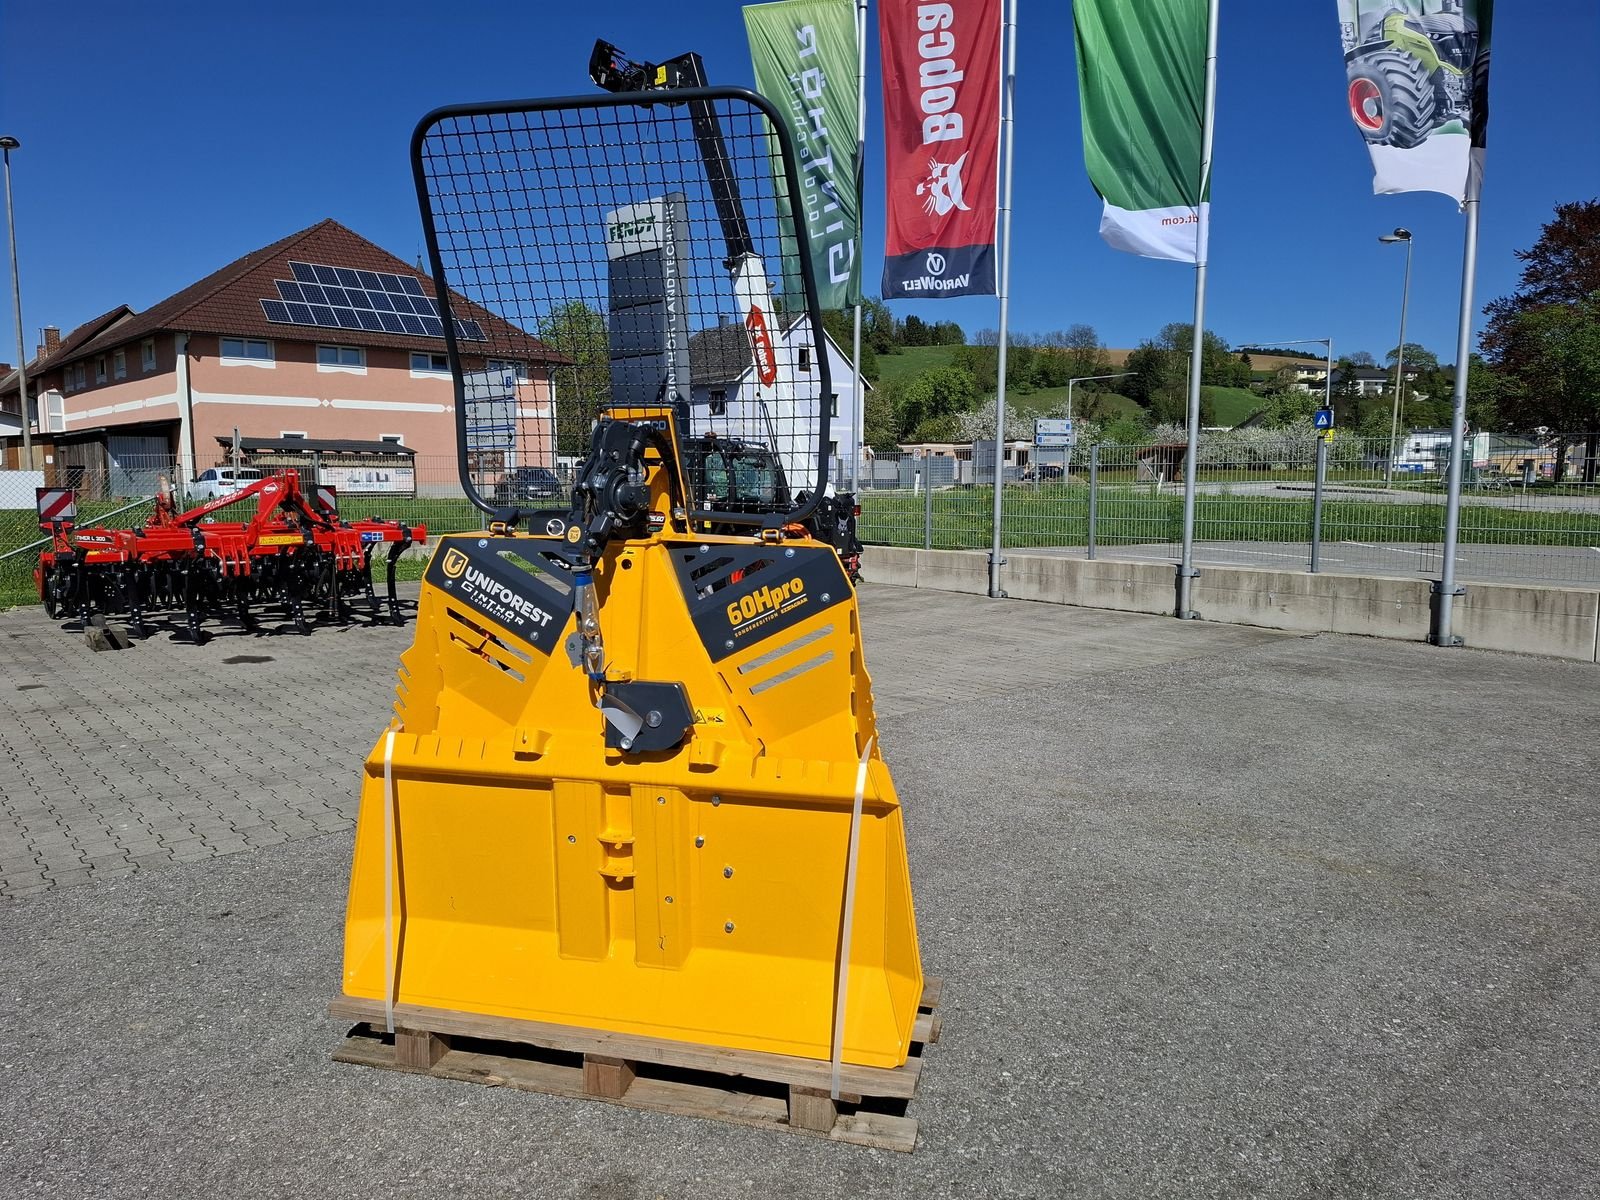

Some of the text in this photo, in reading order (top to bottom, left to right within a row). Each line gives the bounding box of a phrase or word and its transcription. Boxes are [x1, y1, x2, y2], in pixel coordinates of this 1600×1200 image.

[609, 215, 657, 242] FENDT
[465, 565, 553, 627] UNIFOREST
[726, 577, 804, 625] 60Hpro
[734, 612, 779, 638] SONDEREDITION
